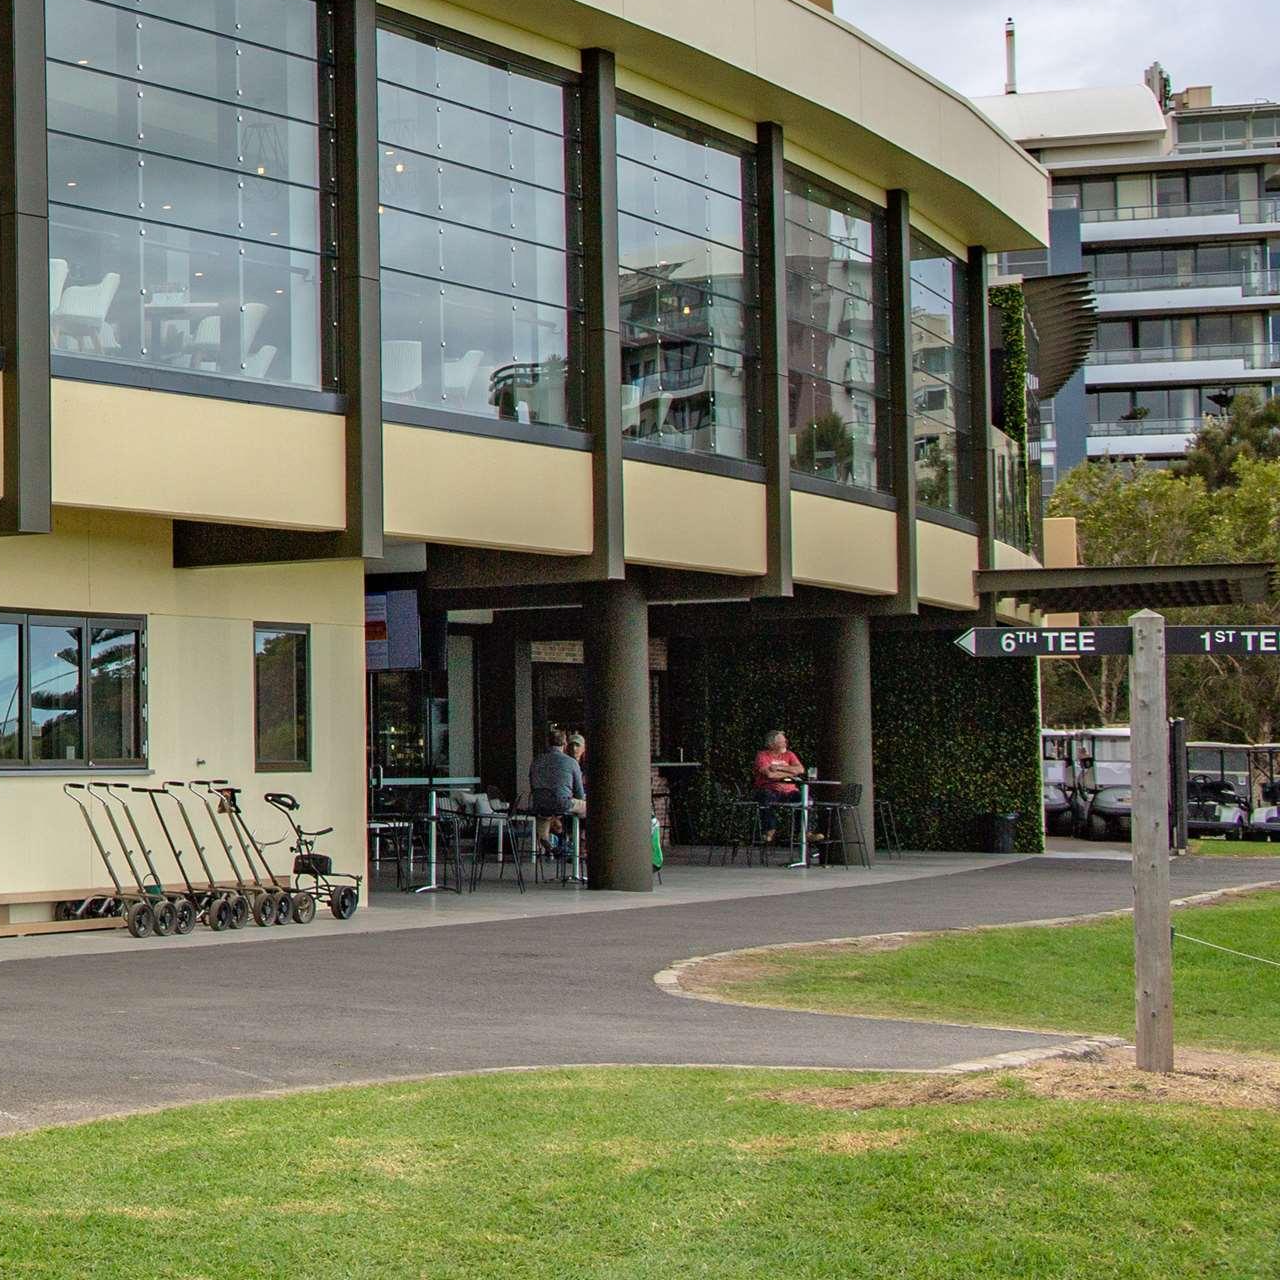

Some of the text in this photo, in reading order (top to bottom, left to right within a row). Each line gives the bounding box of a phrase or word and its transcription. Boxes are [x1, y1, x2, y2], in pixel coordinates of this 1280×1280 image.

[1000, 631, 1096, 653] 6TH TEE
[1200, 630, 1280, 652] 1ST TE
